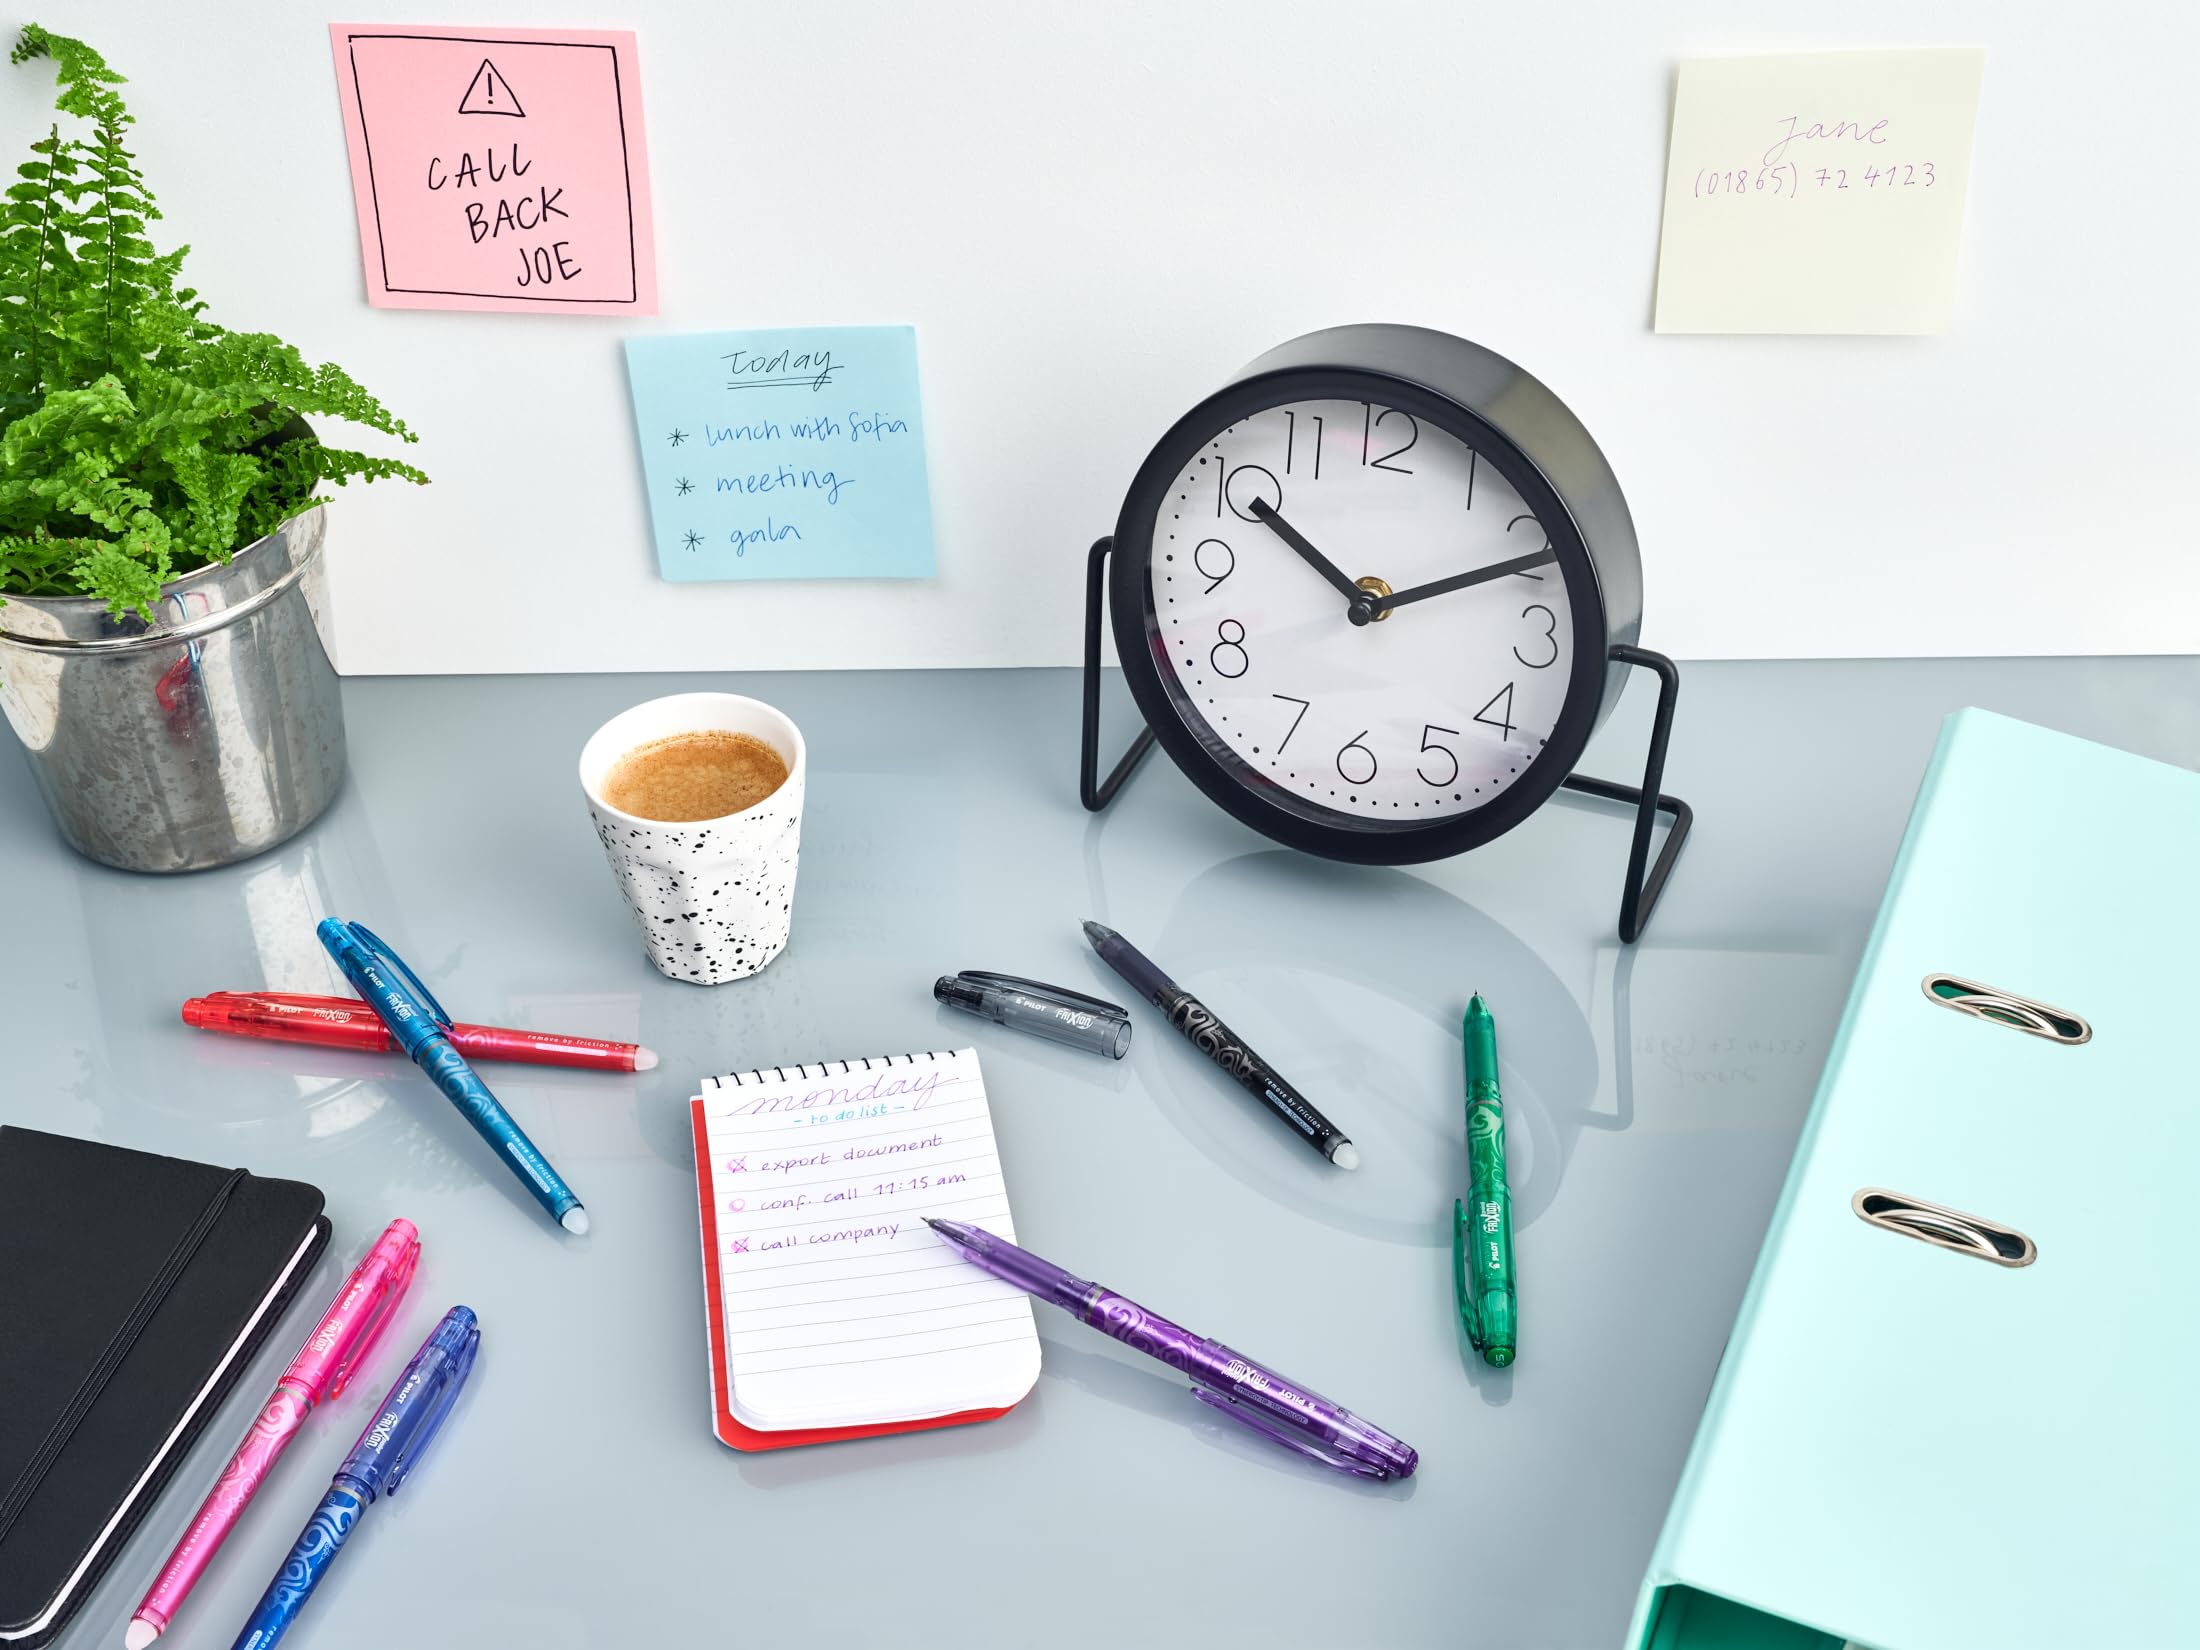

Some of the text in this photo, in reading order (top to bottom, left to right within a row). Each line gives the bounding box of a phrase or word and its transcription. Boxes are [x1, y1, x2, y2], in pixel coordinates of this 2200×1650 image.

[1762, 116, 1889, 167] Jane
[428, 143, 531, 190] CALL
[1694, 162, 1936, 199] (01865) 72 4123
[465, 186, 569, 243] BACK
[517, 241, 582, 287] JOE
[720, 349, 845, 392] Today
[704, 420, 781, 447] lunch
[790, 417, 840, 442] with
[1284, 411, 1323, 480] 11
[1361, 401, 1419, 474] 12
[716, 464, 856, 505] meeting
[1214, 456, 1282, 523] 10
[1466, 445, 1477, 511] 1
[730, 516, 802, 557] gala
[1194, 538, 1235, 595] 9
[1210, 619, 1249, 679] 8
[1512, 604, 1559, 669] 3
[1272, 693, 1310, 755] 7
[1472, 682, 1517, 742] 4
[1336, 730, 1378, 785] 6
[1416, 724, 1460, 787] 5
[368, 972, 385, 989] PILOT
[1023, 1000, 1047, 1012] PILOT
[527, 1033, 610, 1048] remove by friction
[727, 1070, 961, 1116] monday
[835, 1107, 856, 1121] do
[859, 1102, 889, 1119] list
[1264, 1077, 1322, 1130] remove by friction
[508, 1130, 559, 1189] remove by friction
[760, 1133, 944, 1175] export document
[760, 1171, 967, 1212] conf. call 11:15 am
[760, 1222, 900, 1252] call company
[1491, 1242, 1499, 1262] PILOT
[396, 1383, 413, 1405] PILOT
[1279, 1388, 1306, 1407] PILOT
[158, 1511, 213, 1594] remove by friction
